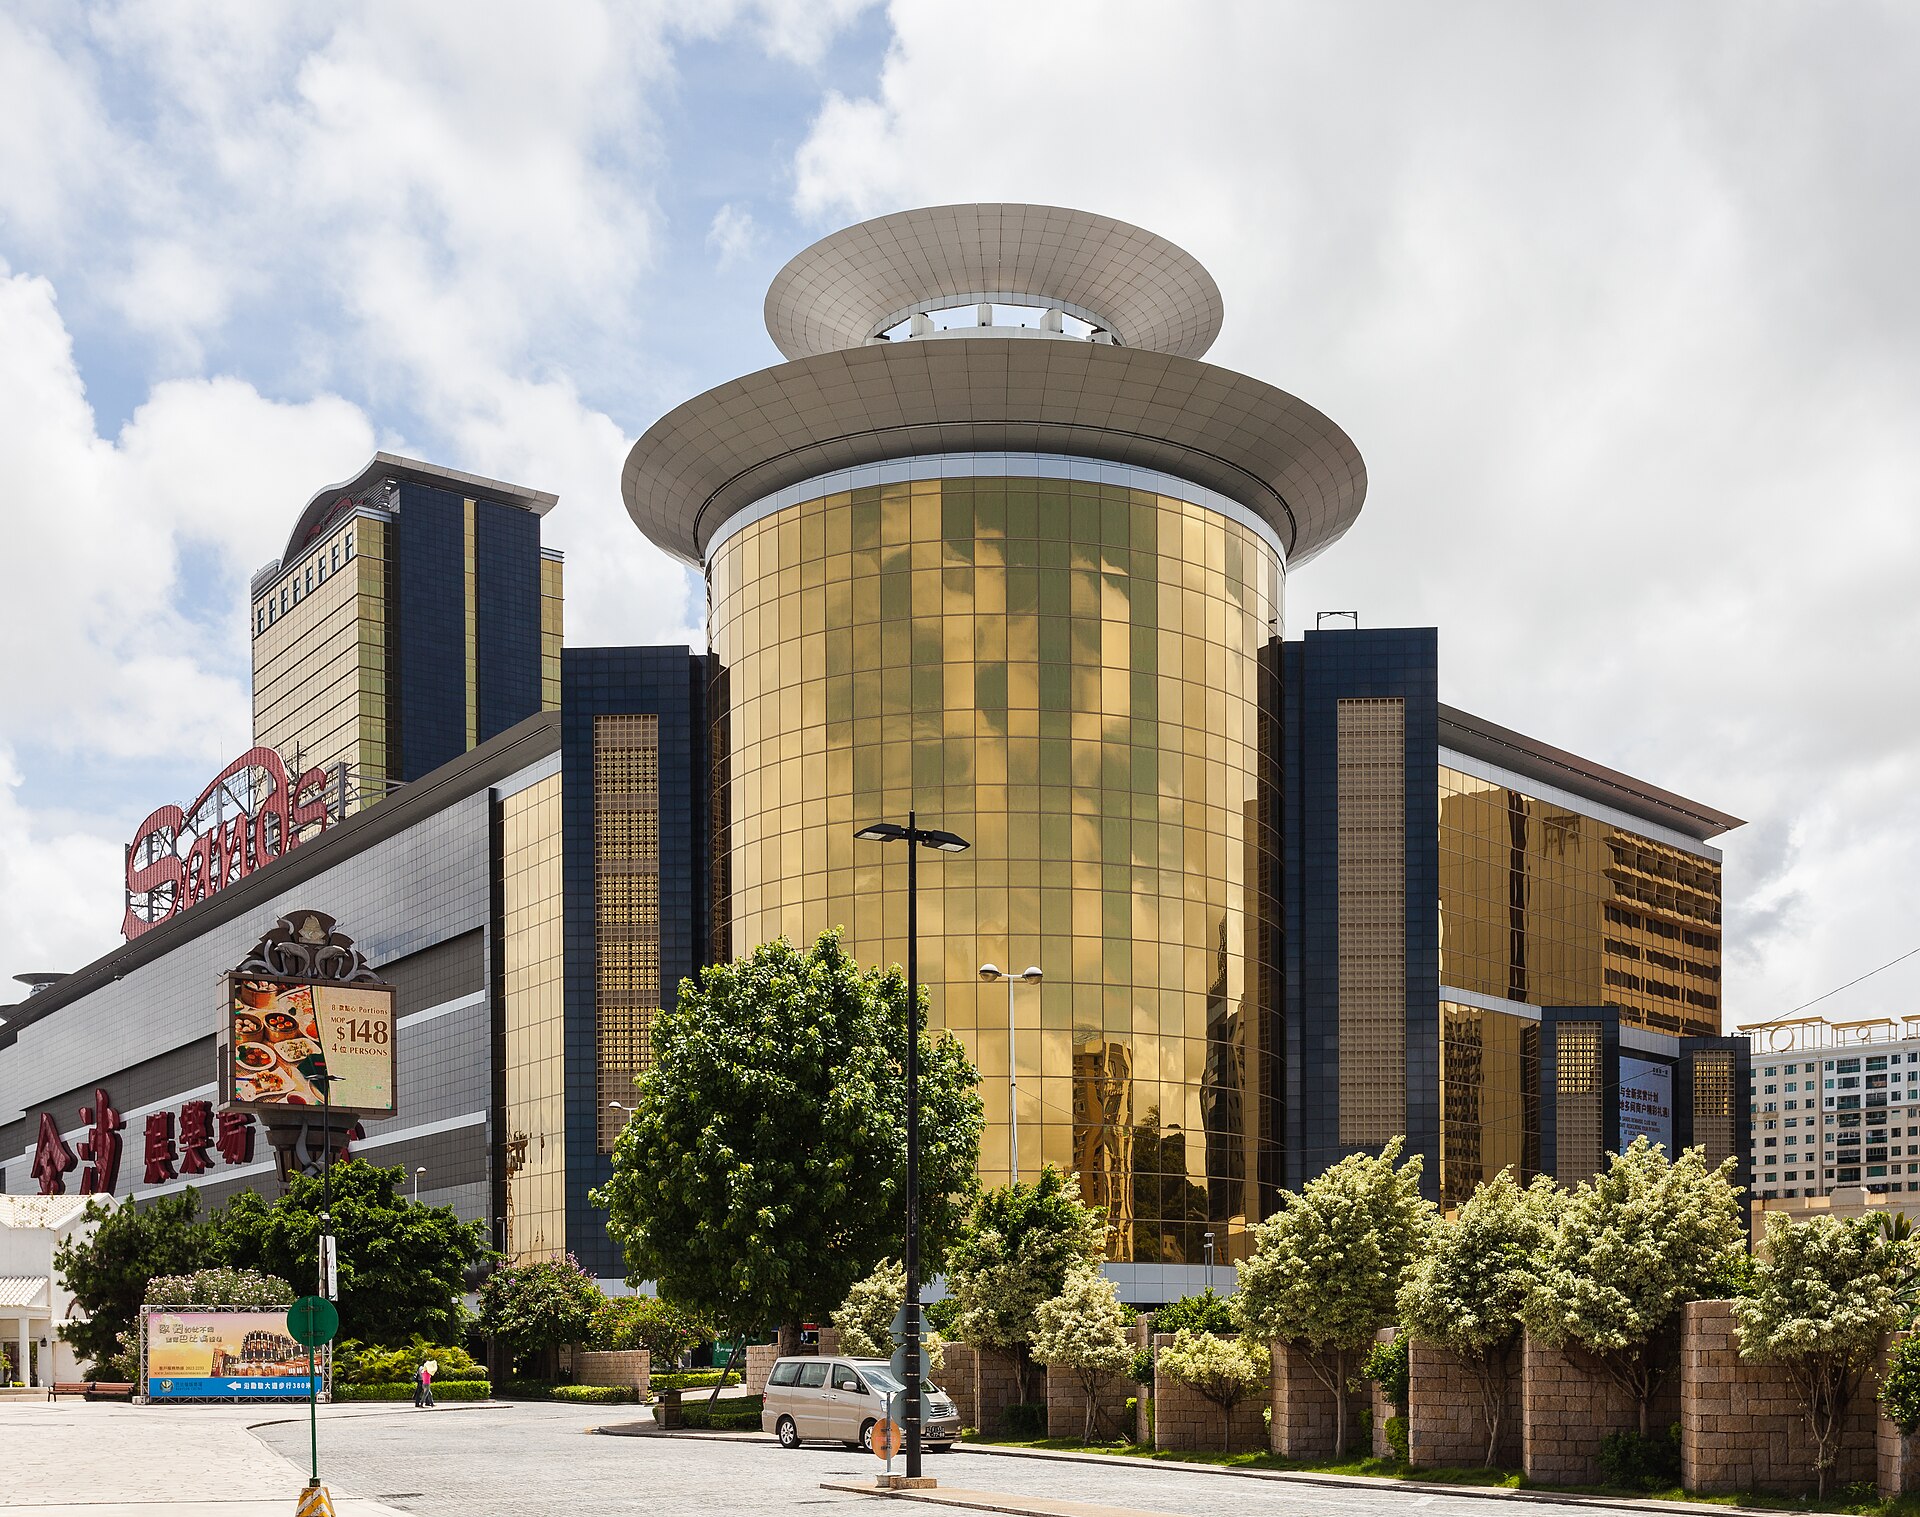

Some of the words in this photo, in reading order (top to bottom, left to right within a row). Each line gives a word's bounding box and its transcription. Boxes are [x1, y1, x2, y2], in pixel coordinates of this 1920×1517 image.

[120, 746, 327, 941] Sands
[331, 1003, 336, 1011] 8
[358, 1006, 388, 1015] Portions
[336, 1018, 388, 1045] $148
[331, 1043, 337, 1053] 4
[339, 1045, 347, 1054] 位
[349, 1046, 388, 1057] PERSONS
